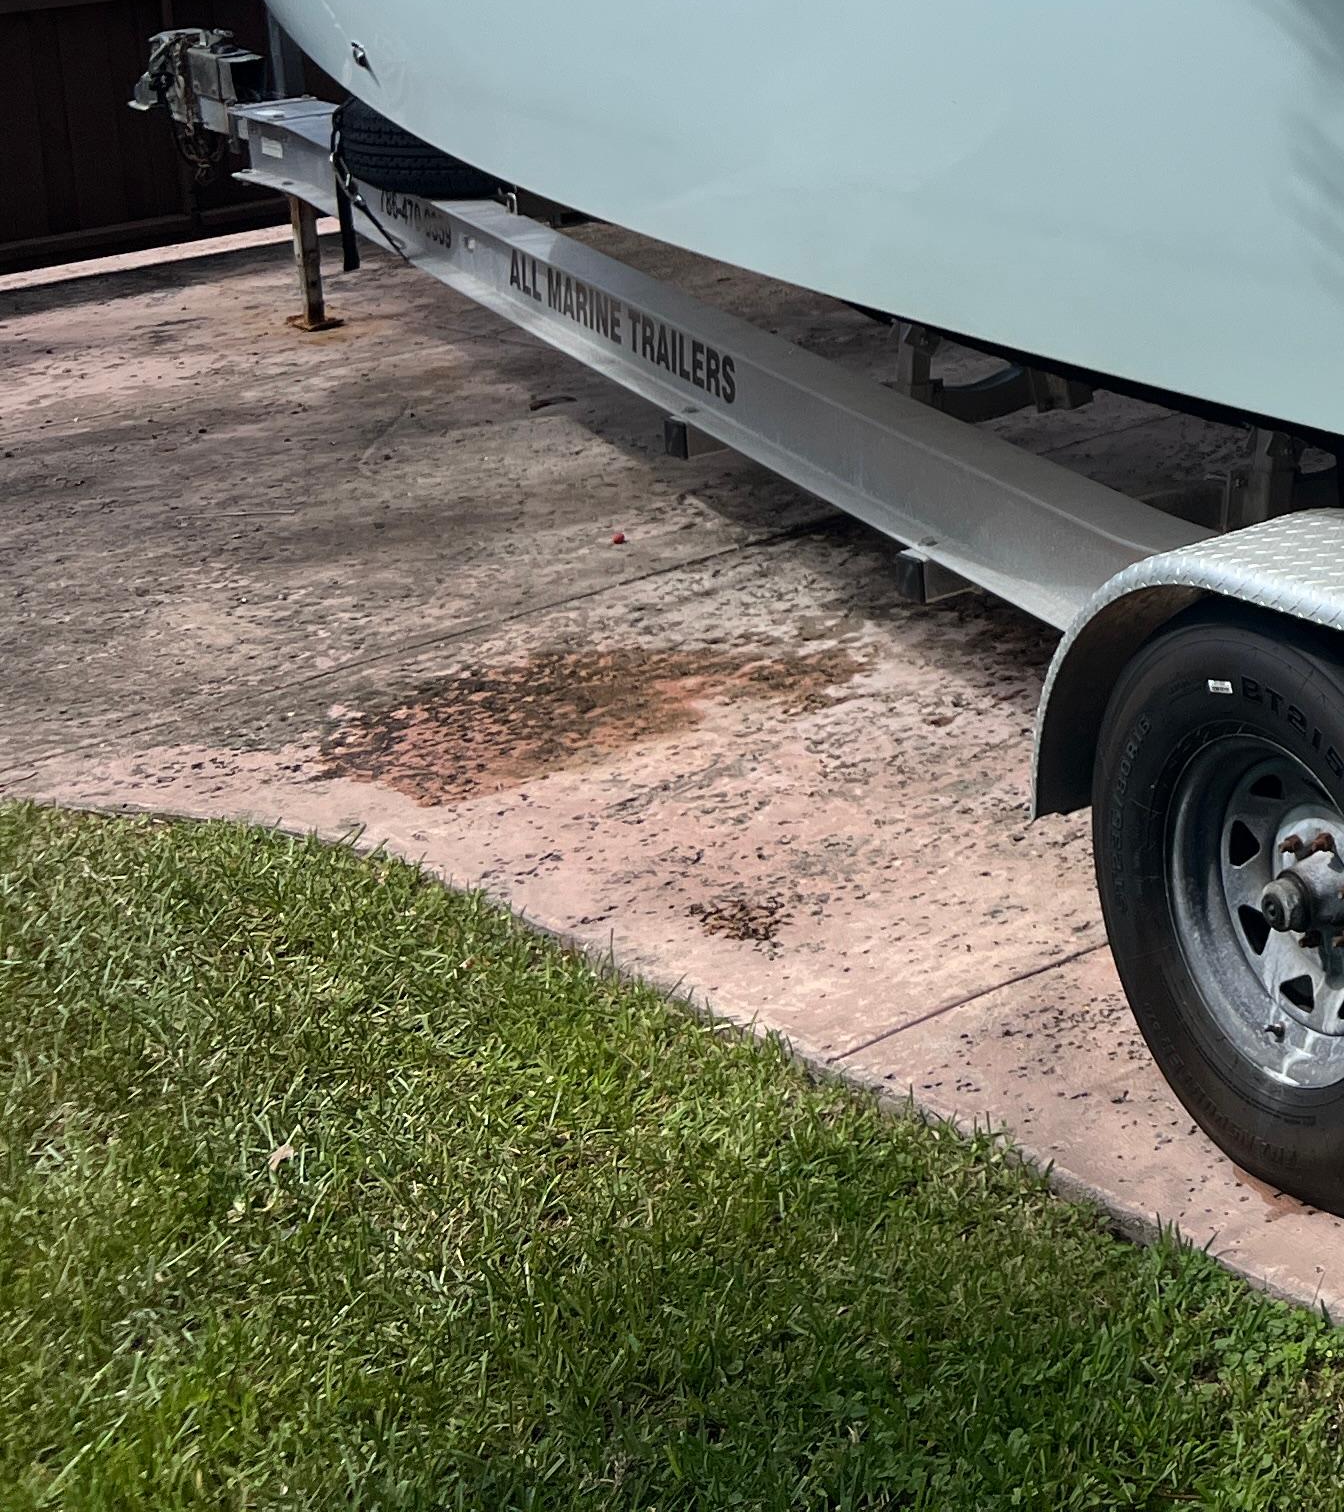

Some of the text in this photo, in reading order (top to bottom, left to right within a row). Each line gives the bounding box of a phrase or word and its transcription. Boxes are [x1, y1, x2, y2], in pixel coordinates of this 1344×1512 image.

[509, 248, 736, 404] ALL MARINE TRAILERS
